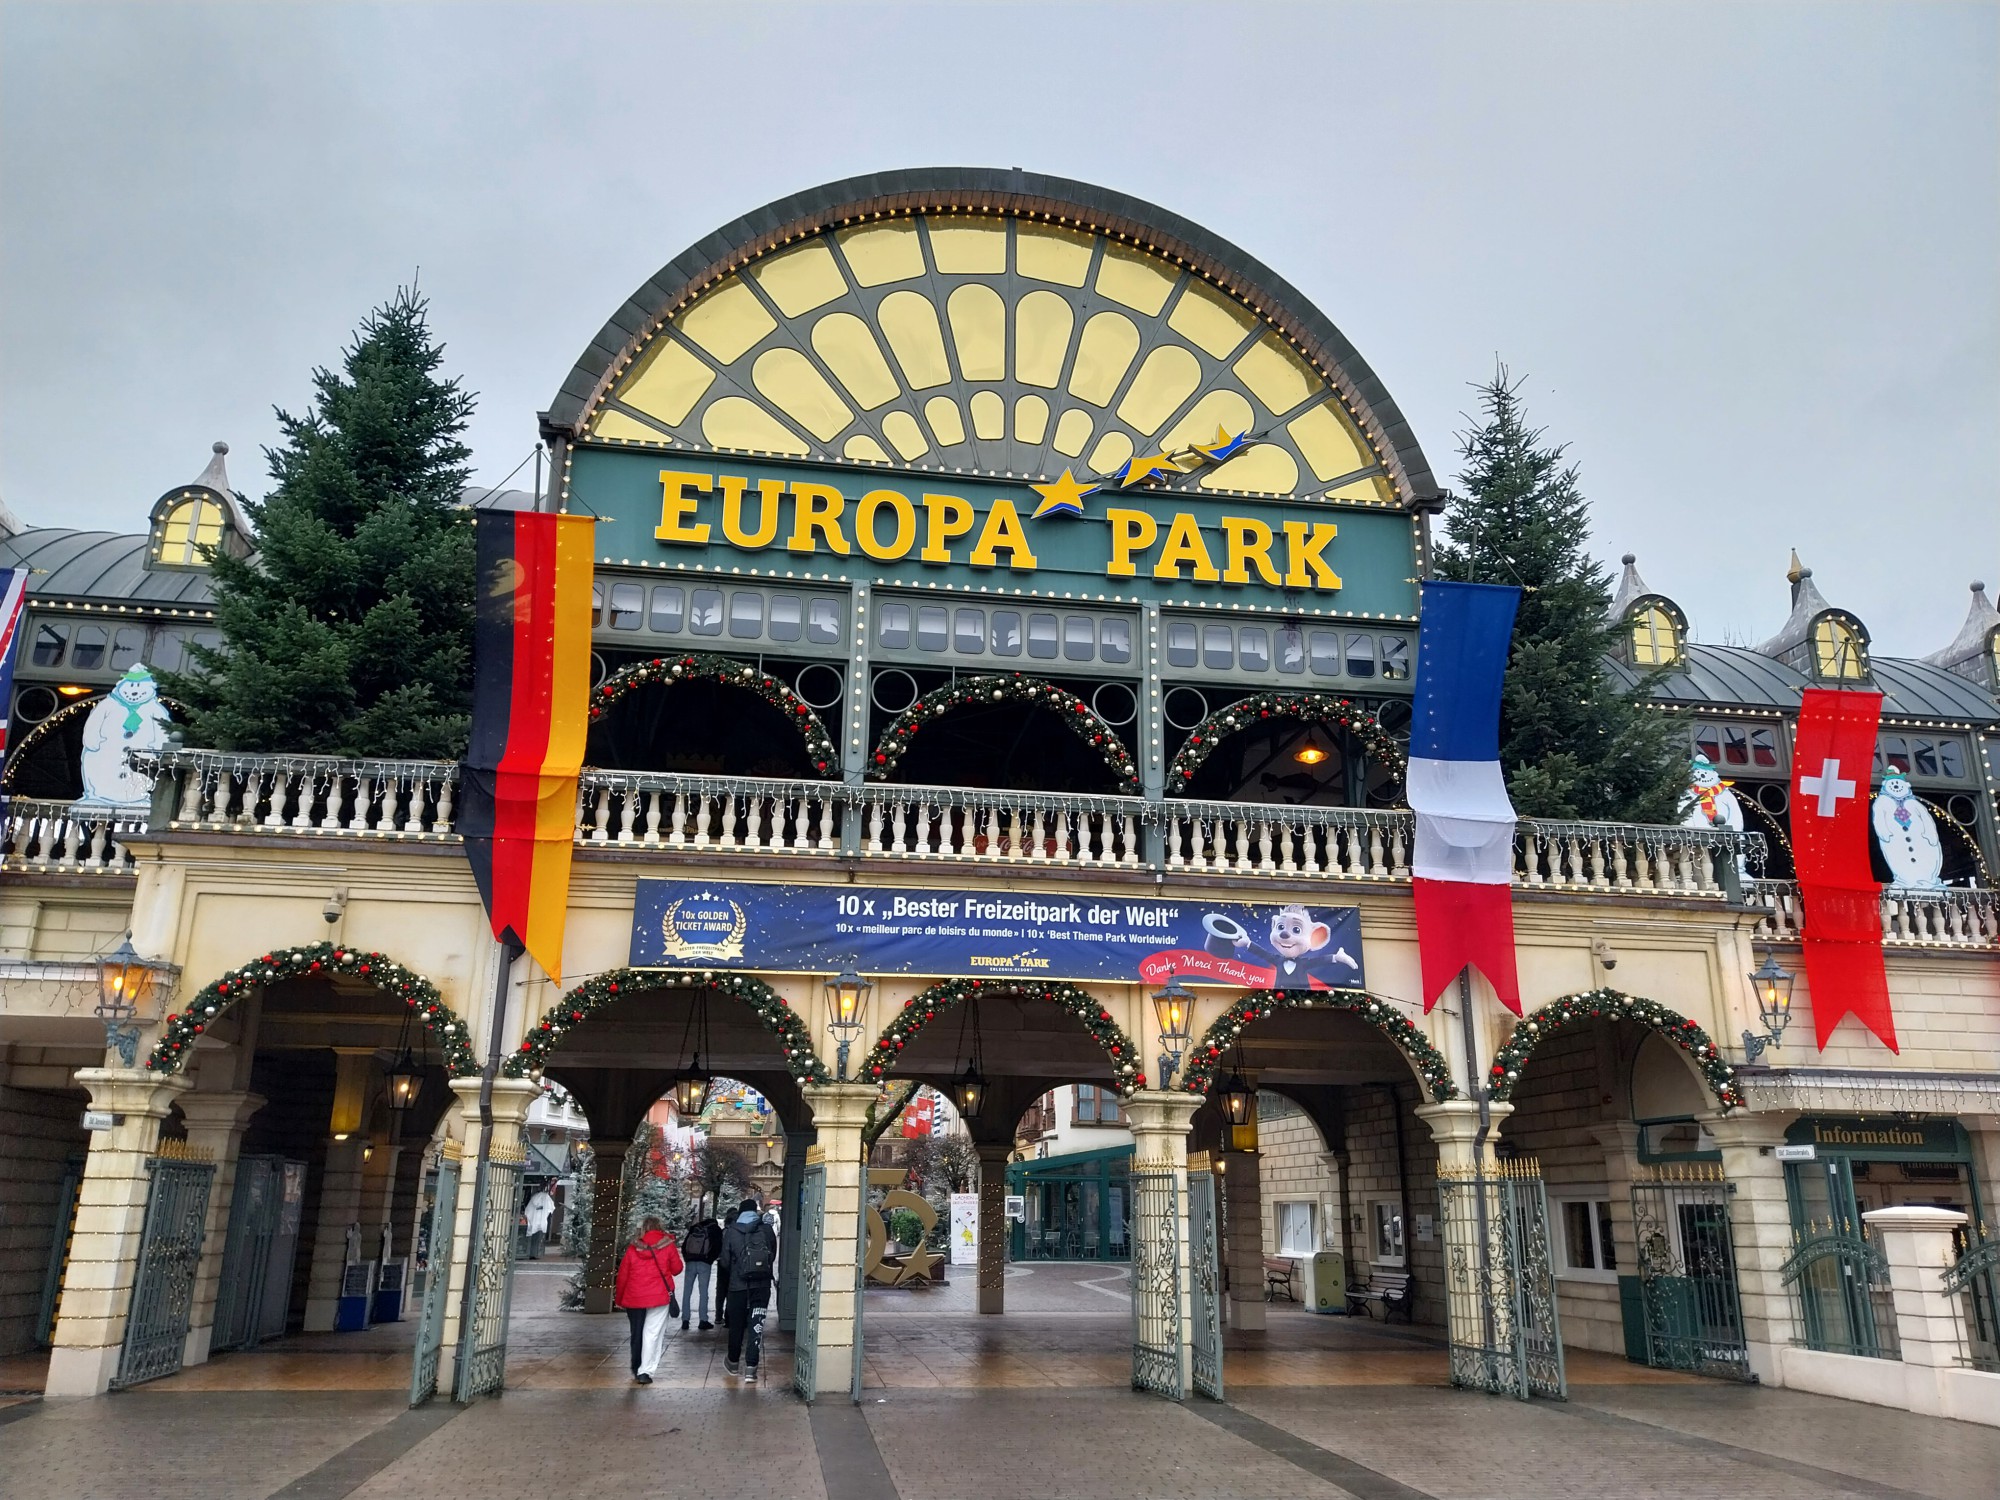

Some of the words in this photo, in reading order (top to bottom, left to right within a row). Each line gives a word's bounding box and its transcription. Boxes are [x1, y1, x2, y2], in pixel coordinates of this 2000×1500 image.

[653, 469, 1038, 571] EUROPA
[1106, 507, 1343, 592] PARK
[681, 910, 696, 920] 10x
[697, 911, 729, 921] GOLDEN
[964, 898, 1082, 926] Freizeitpark
[1087, 904, 1120, 925] der
[675, 921, 702, 931] TICKET
[703, 922, 733, 932] AWARD
[902, 927, 923, 936] parc
[925, 925, 936, 935] de
[938, 926, 966, 936] loisirs
[968, 926, 980, 936] du
[1073, 931, 1103, 942] Theme
[1105, 933, 1126, 943] Park
[970, 956, 1014, 968] EUROPA
[1020, 958, 1050, 969] PARK
[1146, 962, 1176, 977] Danke
[1181, 955, 1212, 970] Merci
[1217, 962, 1247, 980] Thank
[1249, 972, 1265, 986] you
[1813, 1125, 1924, 1145] Information
